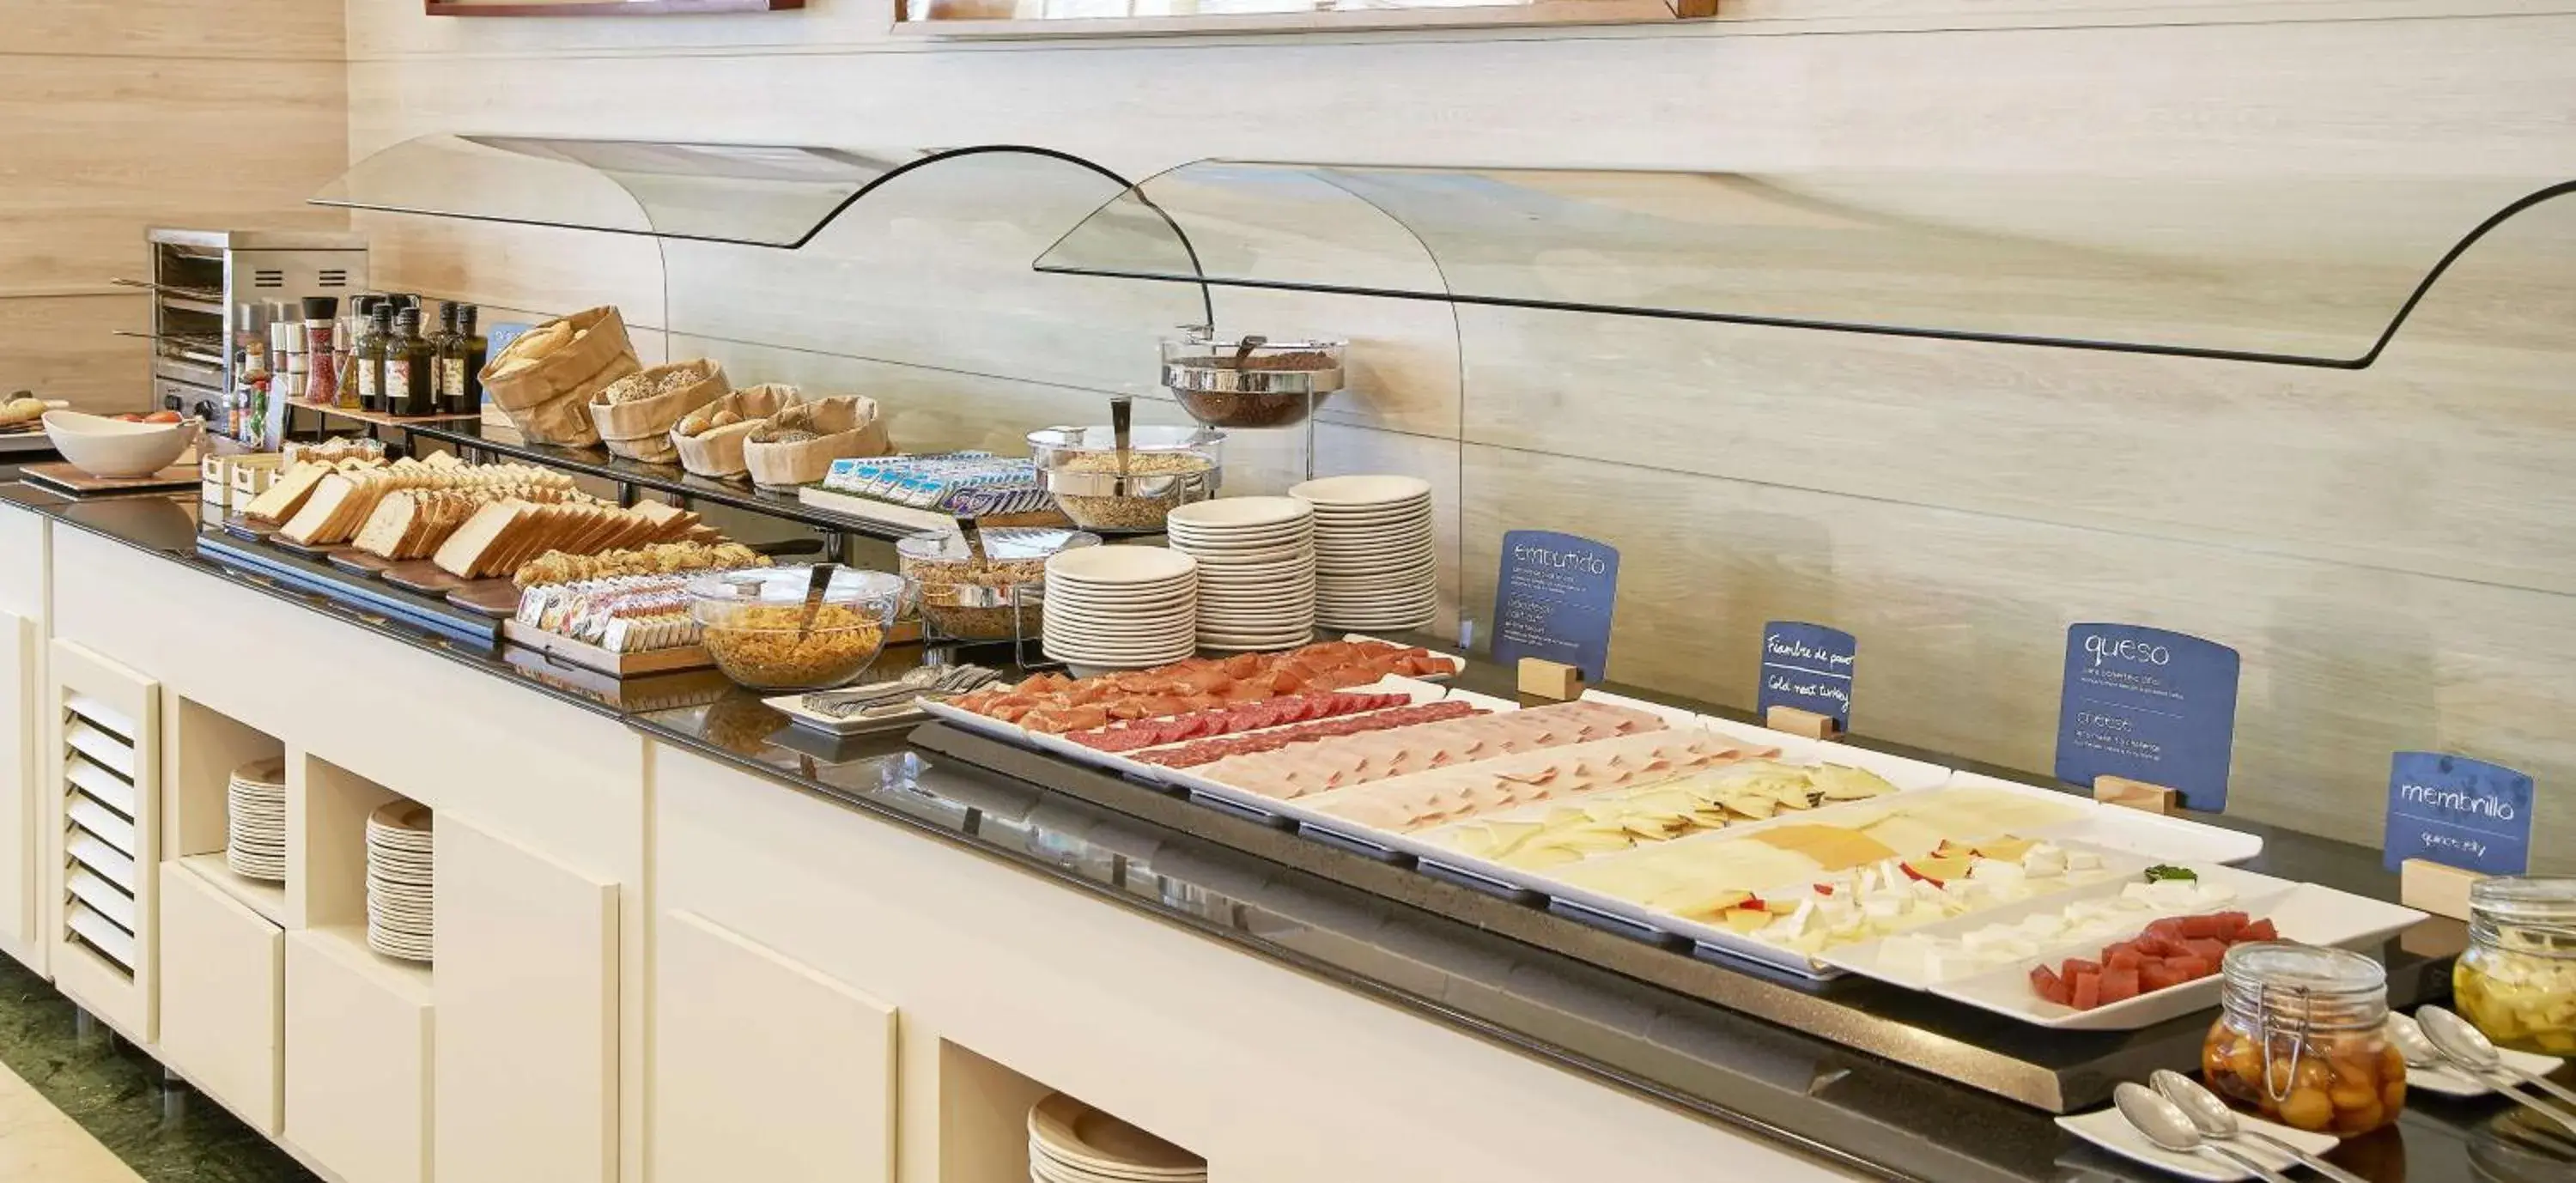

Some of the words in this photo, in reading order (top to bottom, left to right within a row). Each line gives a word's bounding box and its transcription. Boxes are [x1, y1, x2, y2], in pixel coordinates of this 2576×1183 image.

[2085, 634, 2170, 666] queso
[1769, 674, 1790, 692] Cold
[2402, 783, 2514, 820] membrillo
